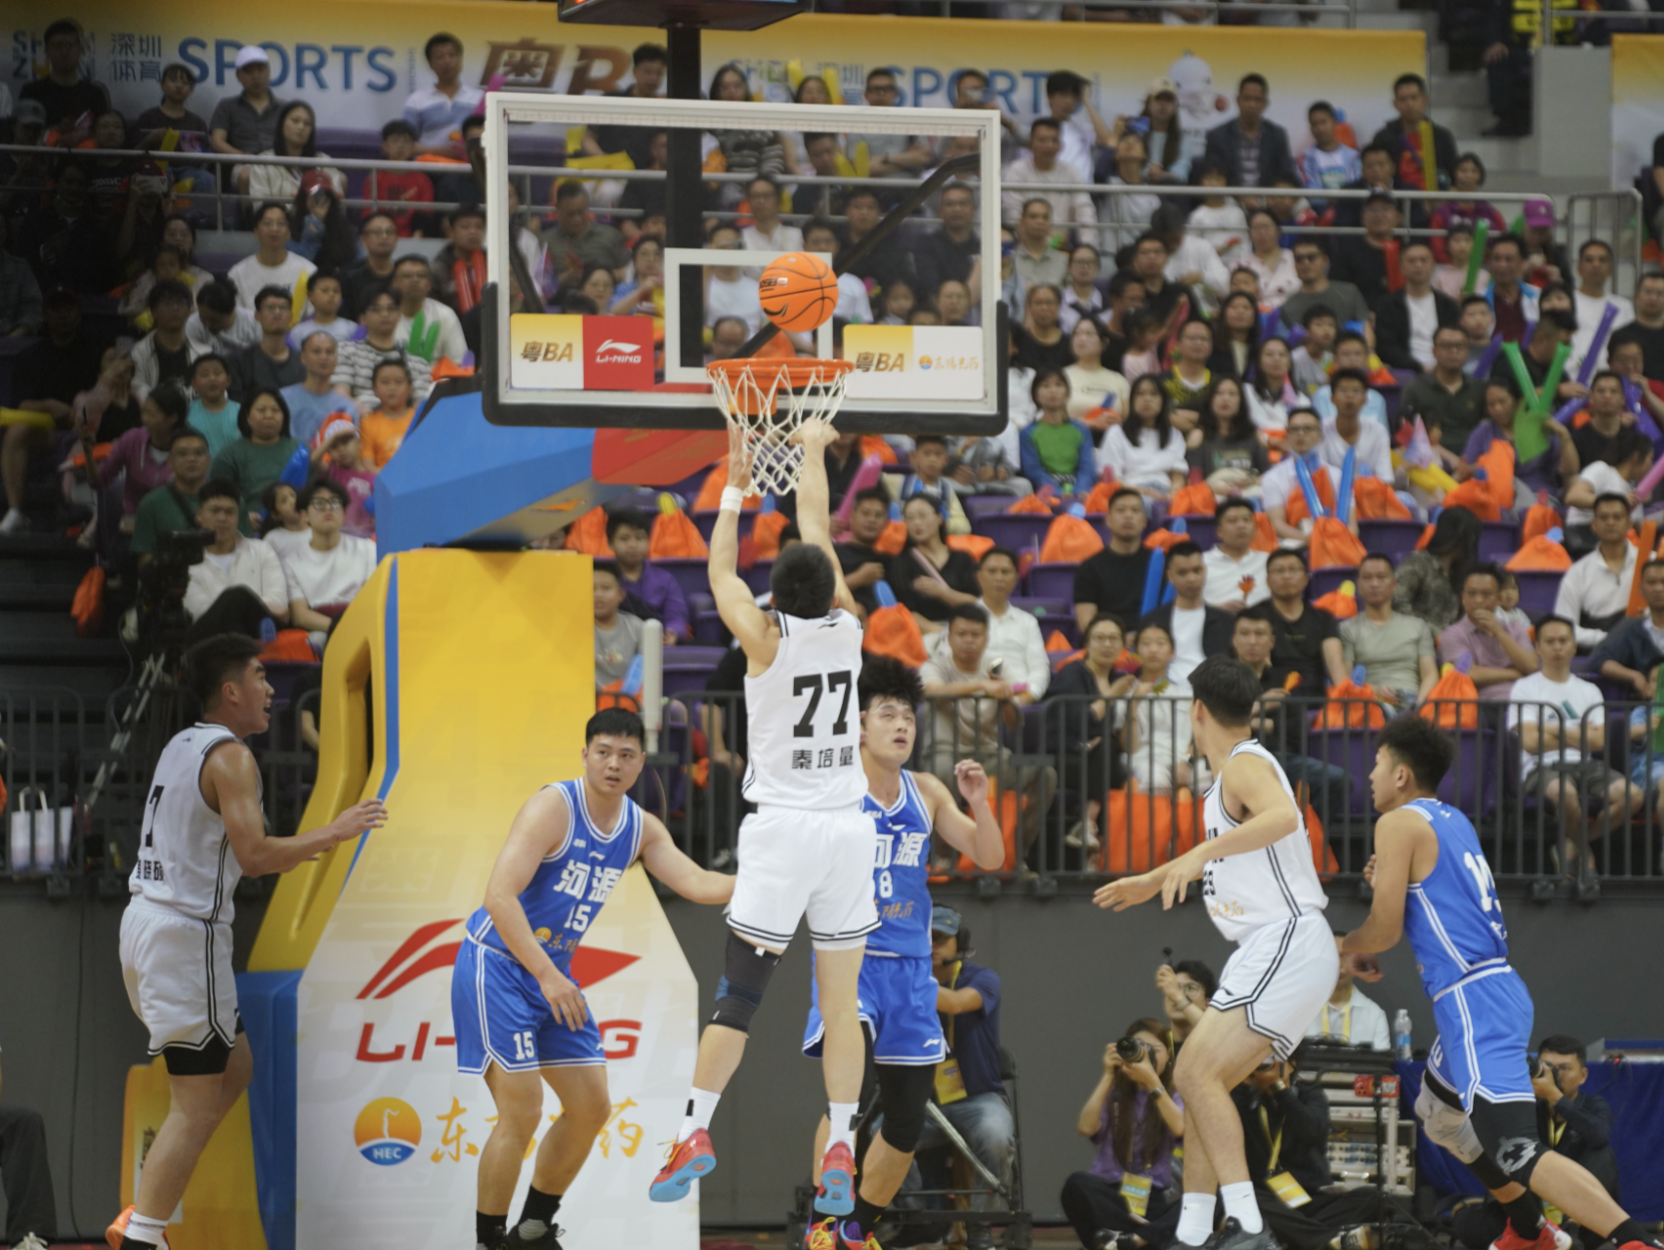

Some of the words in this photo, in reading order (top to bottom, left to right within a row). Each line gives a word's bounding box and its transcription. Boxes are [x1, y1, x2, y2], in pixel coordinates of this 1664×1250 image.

[110, 33, 162, 57] 深圳
[110, 59, 162, 82] 体育
[178, 36, 398, 93] SPORTS
[520, 341, 574, 363] 粤BA
[595, 355, 642, 364] LI-NING
[793, 669, 852, 738] 77
[145, 784, 165, 848] 7
[879, 869, 894, 898] 8
[563, 903, 592, 932] 15
[355, 1019, 643, 1063] LI-G
[513, 1031, 536, 1061] 15
[430, 1096, 644, 1164] 东药
[372, 1146, 402, 1160] HEC
